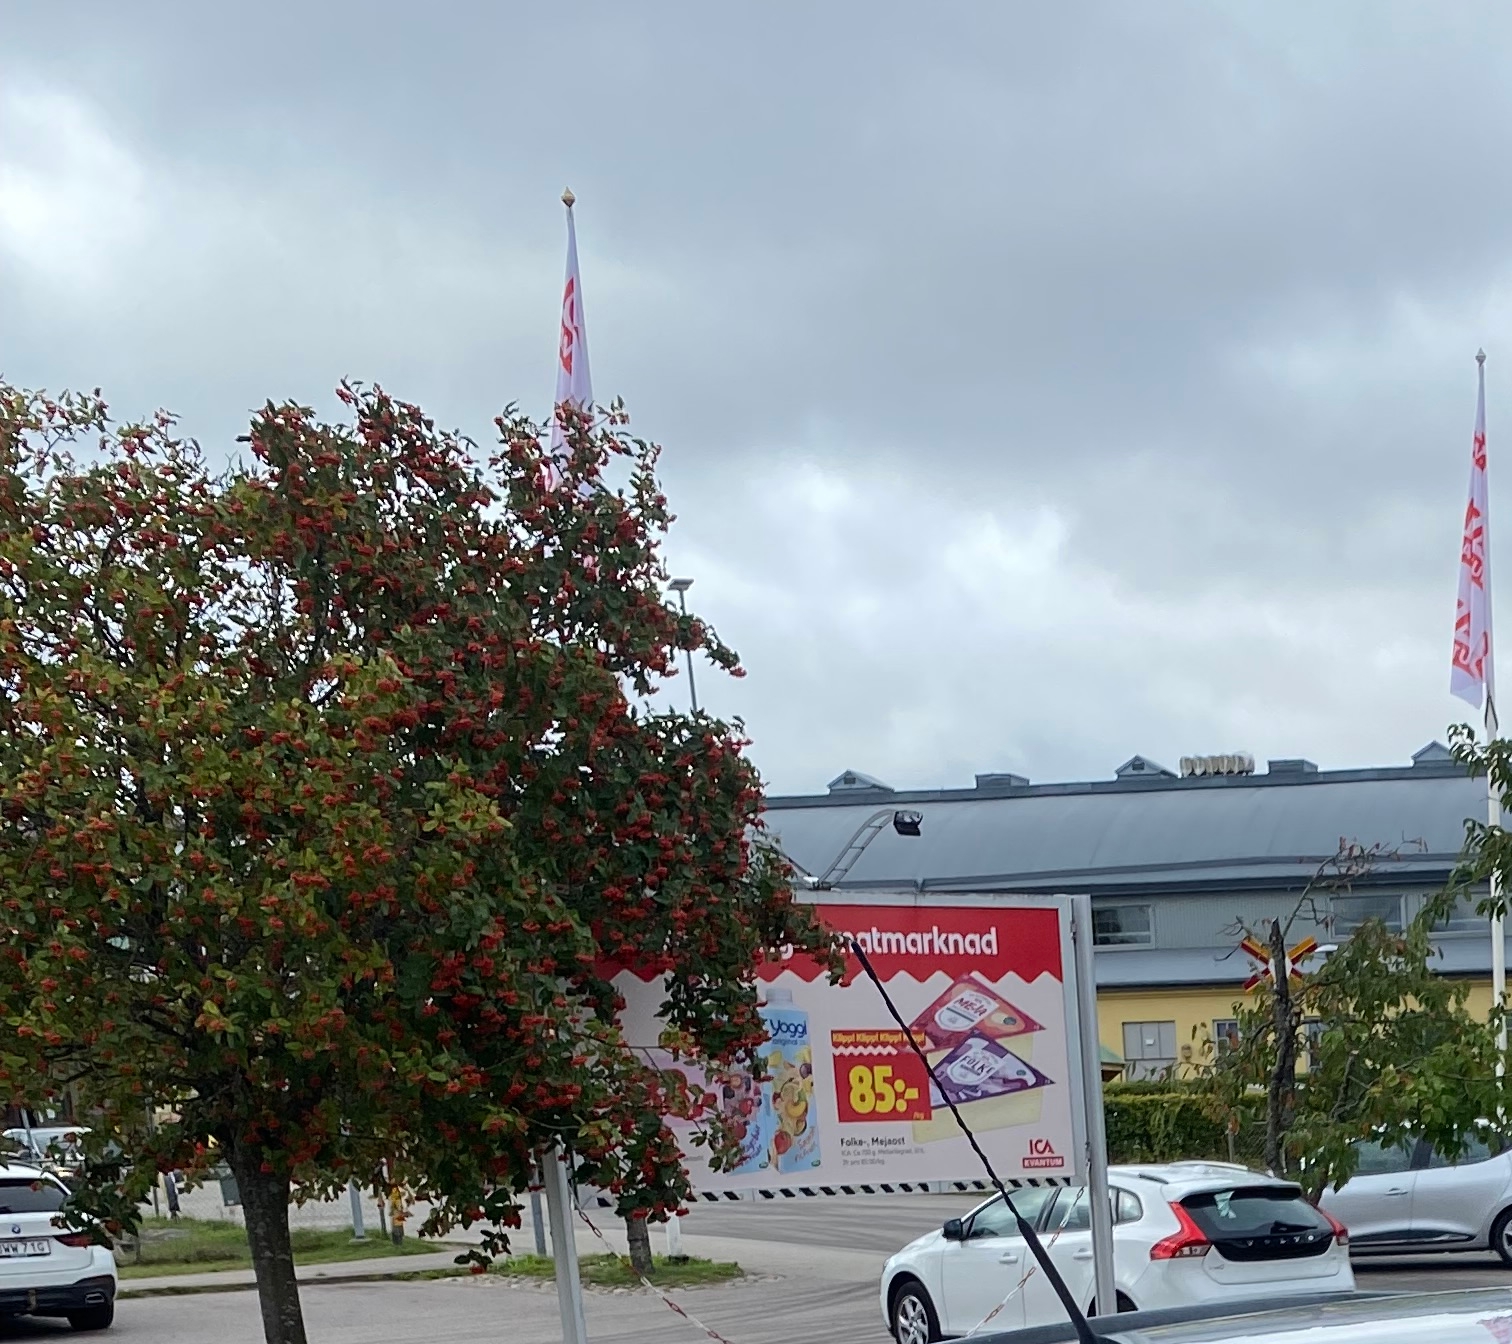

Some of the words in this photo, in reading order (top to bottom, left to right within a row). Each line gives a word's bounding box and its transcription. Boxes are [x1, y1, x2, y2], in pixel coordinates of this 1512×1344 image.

[848, 1064, 919, 1114] 85:-
[1029, 1138, 1055, 1155] ICA
[1024, 1158, 1063, 1167] KVANTUM
